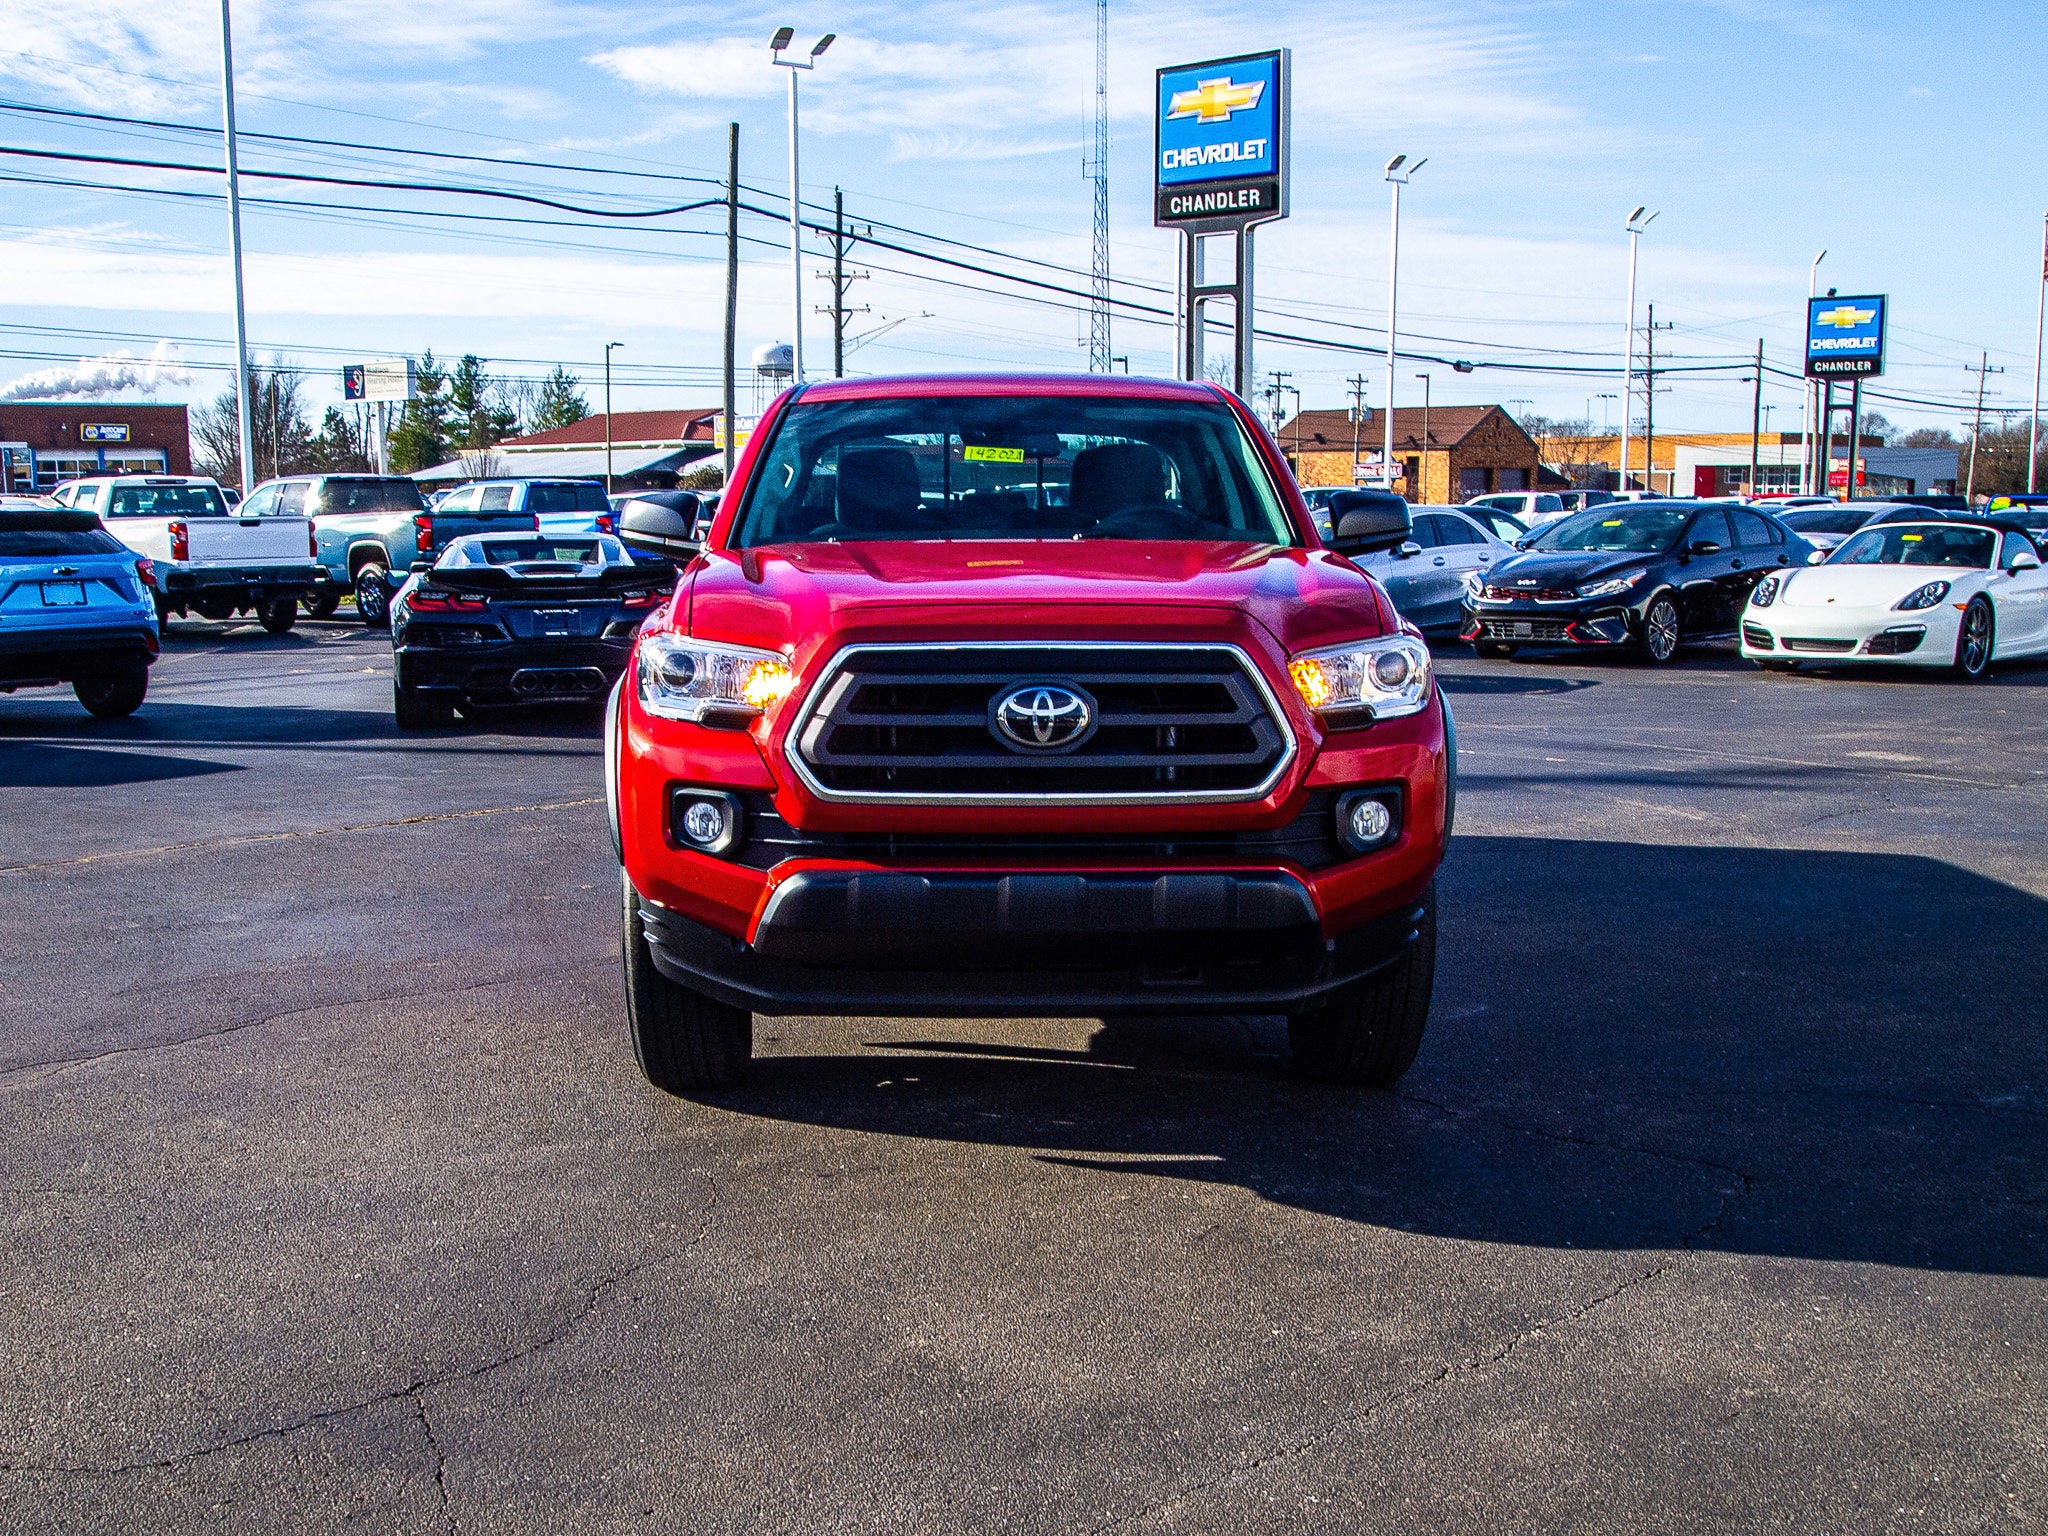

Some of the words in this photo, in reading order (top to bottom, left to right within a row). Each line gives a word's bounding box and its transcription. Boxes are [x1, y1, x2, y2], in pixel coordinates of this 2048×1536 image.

[1162, 138, 1268, 170] CHEVROLET
[1170, 188, 1261, 214] CHANDLER
[1810, 336, 1879, 350] CHEVROLET
[1814, 360, 1872, 372] CHANDLER
